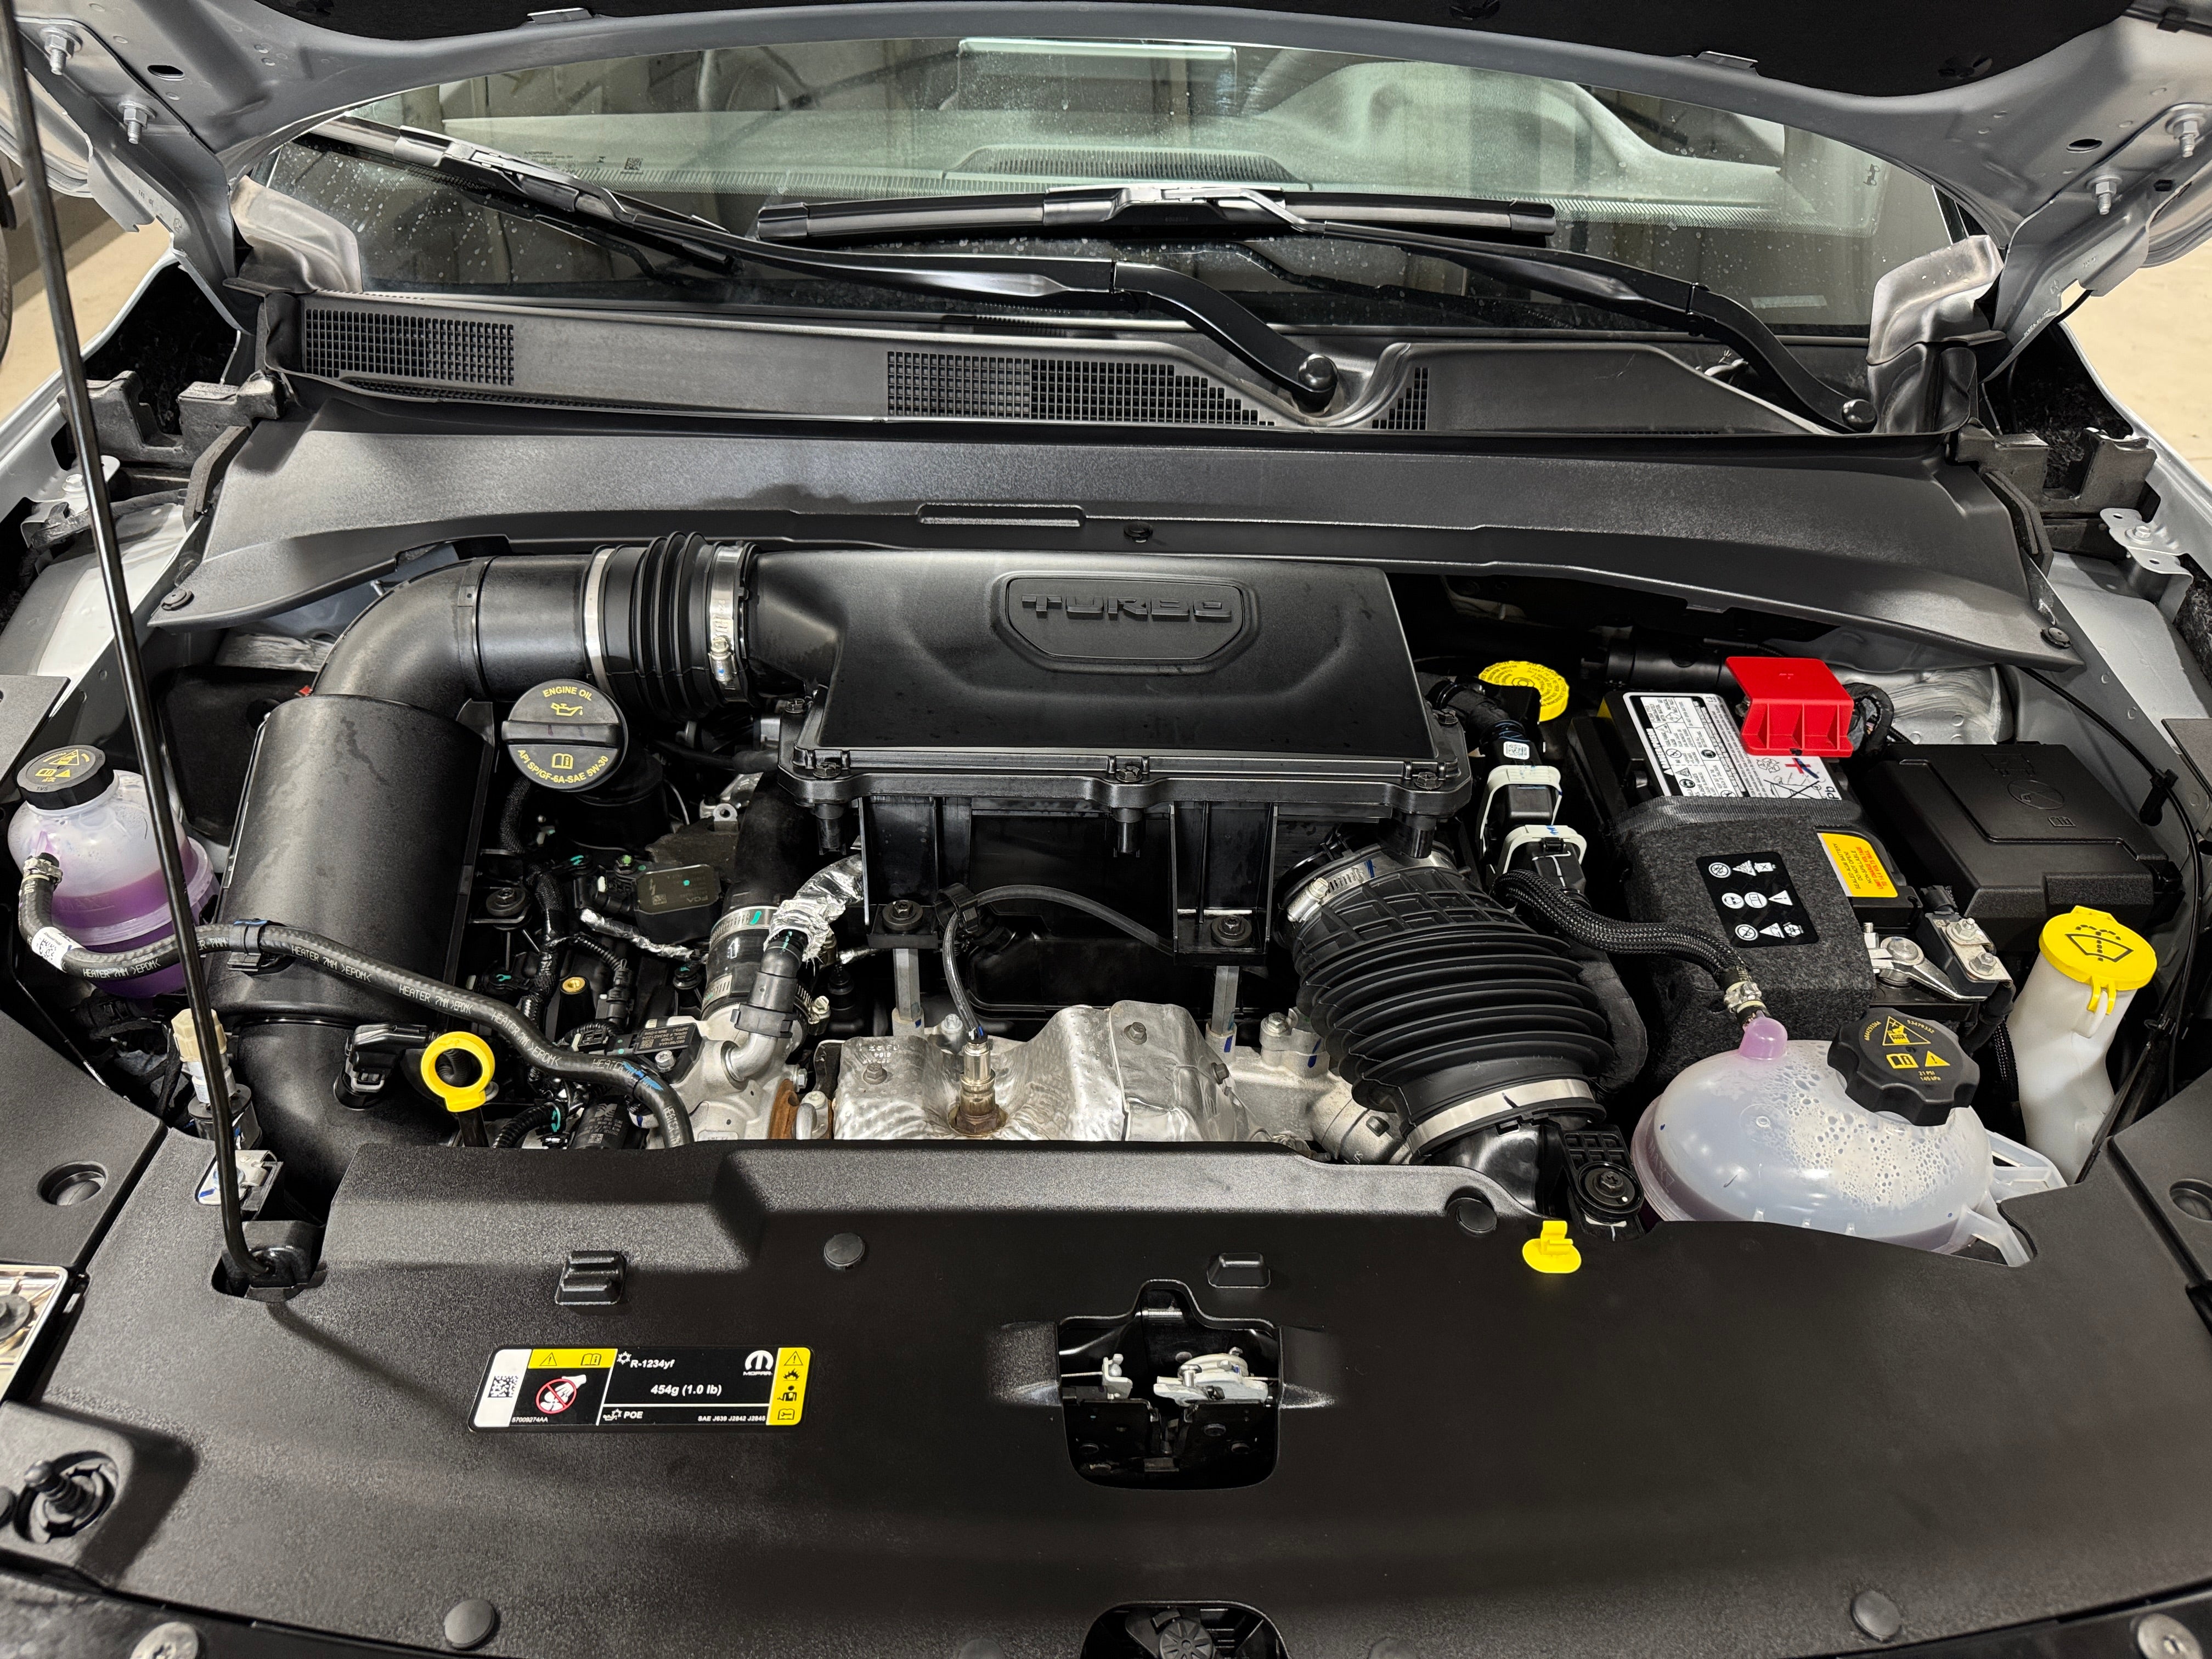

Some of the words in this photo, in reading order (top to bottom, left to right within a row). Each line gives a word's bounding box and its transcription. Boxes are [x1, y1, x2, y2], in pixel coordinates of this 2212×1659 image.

[1022, 594, 1232, 619] TURBO
[543, 686, 578, 698] ENGINE
[579, 689, 592, 701] OIL
[517, 749, 529, 764] API
[528, 761, 586, 783] SP/GF-6A-SAE
[586, 755, 609, 776] 5W-30
[1825, 786, 1839, 799] Pb
[1832, 843, 1846, 861] BATTERY
[1855, 847, 1869, 862] VOLTAGE
[1843, 862, 1852, 872] AGM
[1850, 850, 1872, 884] NON-SPILLABLE
[1850, 865, 1859, 873] NOT
[1847, 872, 1861, 889] SEALED
[1874, 879, 1884, 889] LIMIT
[291, 945, 320, 963] HEATER
[323, 956, 337, 970] 7MM
[83, 968, 110, 978] HEATER
[114, 967, 129, 978] 7MM
[399, 984, 431, 1003] HEATER
[435, 995, 450, 1008] 7MM
[491, 1011, 520, 1038] HEATER
[630, 1358, 674, 1369] R-1234yf
[651, 1385, 679, 1397] 454g
[682, 1384, 704, 1396] (1.0
[707, 1385, 722, 1397] lb)
[624, 1411, 642, 1419] POE
